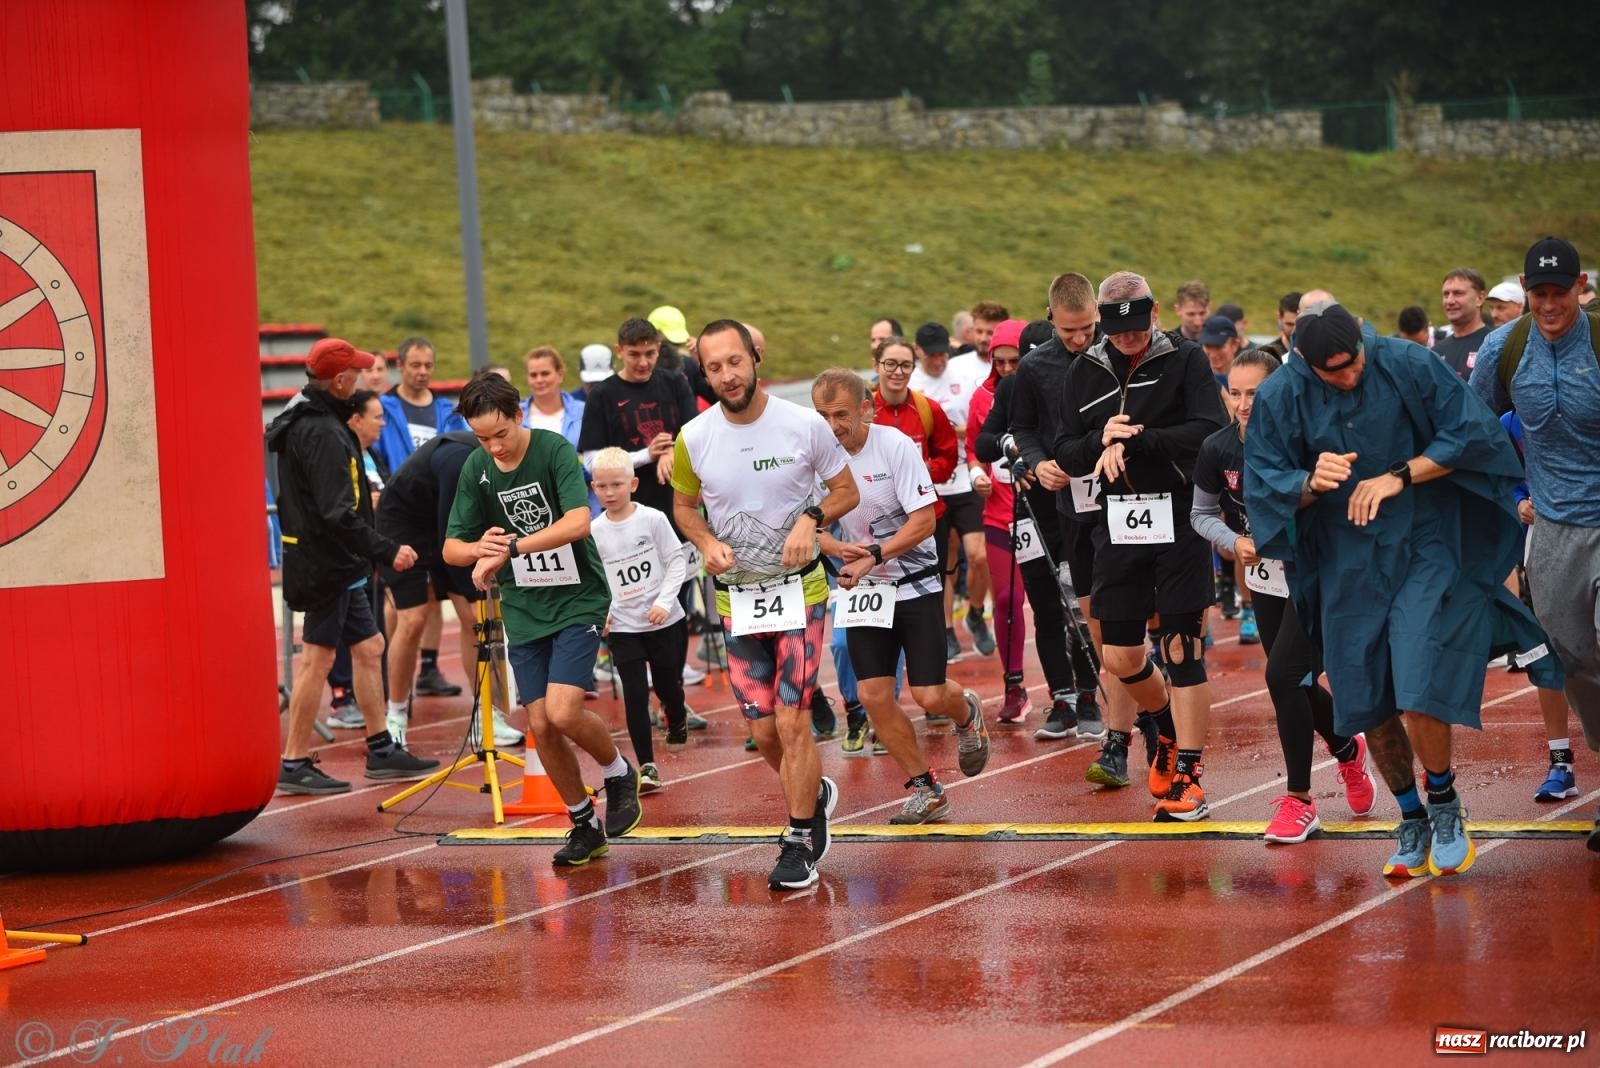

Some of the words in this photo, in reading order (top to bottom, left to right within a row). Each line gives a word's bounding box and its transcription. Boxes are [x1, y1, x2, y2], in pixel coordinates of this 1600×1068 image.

[753, 456, 780, 471] UTA
[525, 521, 545, 533] CAMP
[1126, 509, 1153, 529] 64
[524, 552, 565, 572] 111
[617, 561, 651, 587] 109
[753, 595, 784, 619] 54
[848, 593, 883, 613] 100
